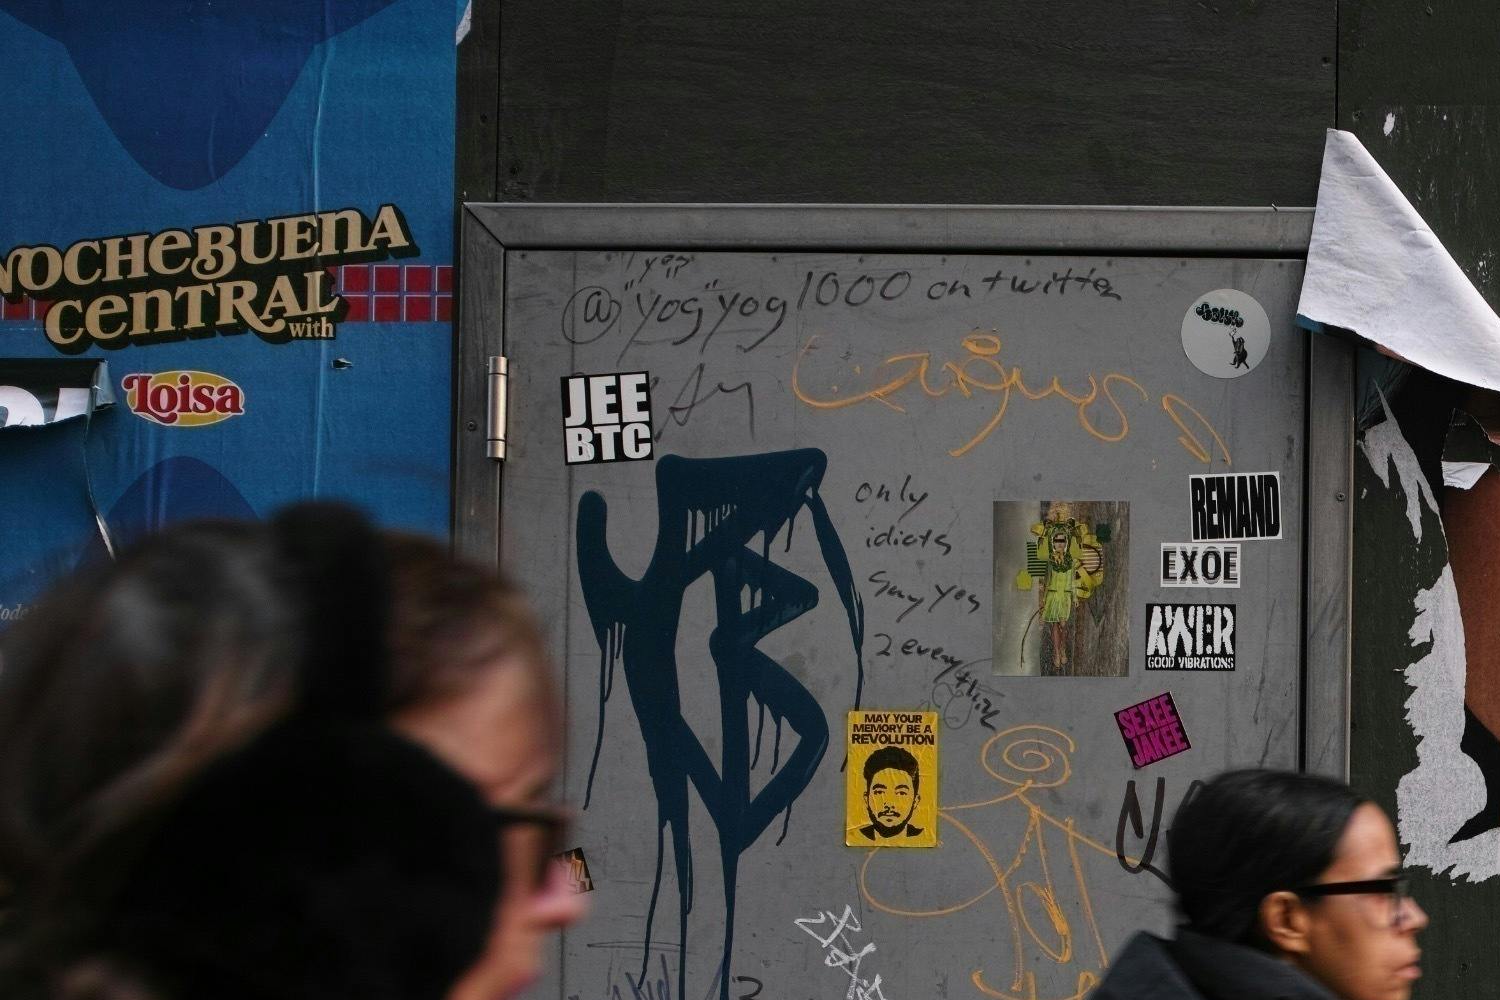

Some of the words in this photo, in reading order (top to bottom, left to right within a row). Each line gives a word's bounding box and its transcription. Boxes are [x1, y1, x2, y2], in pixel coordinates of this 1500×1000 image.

[288, 319, 335, 339] with
[121, 371, 245, 424] Loisa
[564, 372, 651, 427] JEE
[564, 422, 652, 464] BTC
[1190, 474, 1280, 541] REMAND
[1162, 547, 1240, 585] EXOE
[1146, 656, 1175, 670] GOOD
[1177, 656, 1235, 670] VIBRATIONS
[853, 723, 904, 733] MEMORY
[906, 724, 920, 734] BE
[923, 725, 933, 734] A
[864, 713, 891, 724] MAY
[893, 714, 923, 724] YOUR
[1117, 693, 1177, 739] SEXEE
[851, 733, 935, 746] REVOLUTION
[1132, 722, 1189, 767] JAKEE
